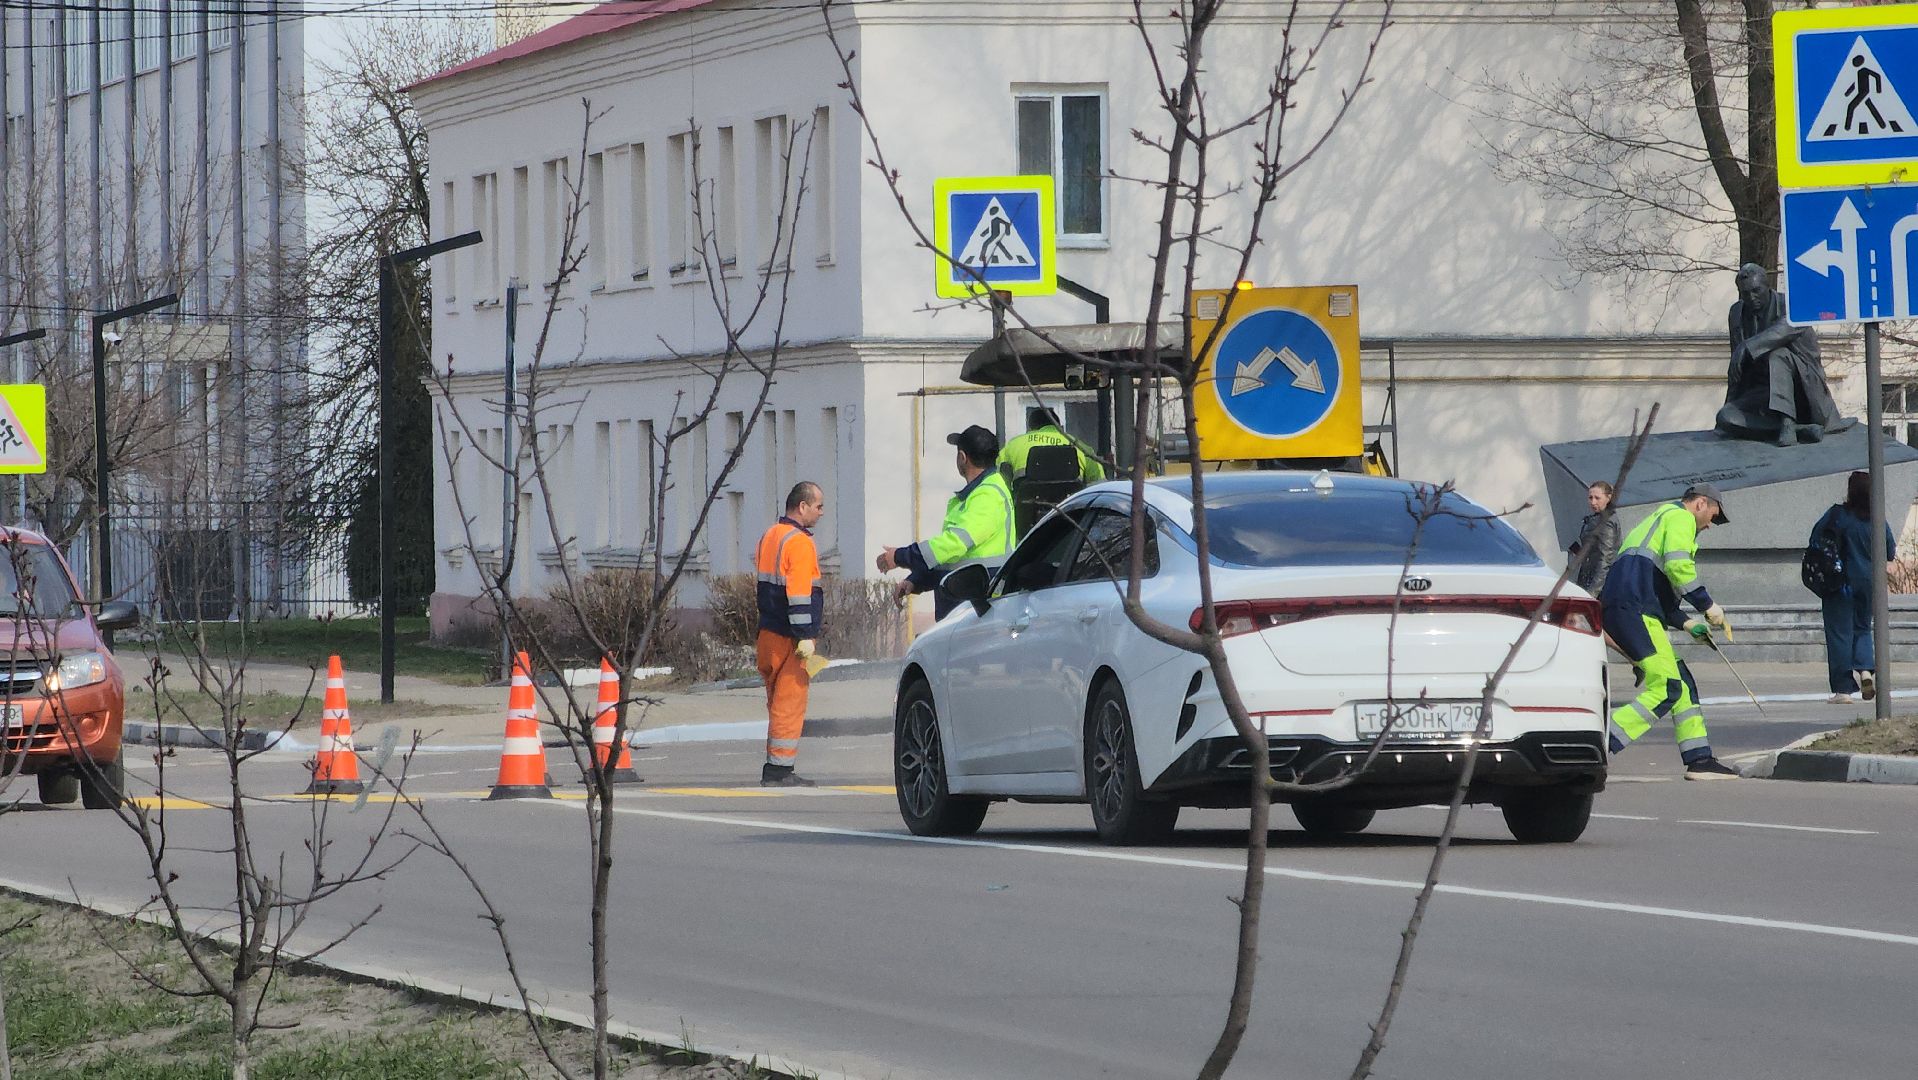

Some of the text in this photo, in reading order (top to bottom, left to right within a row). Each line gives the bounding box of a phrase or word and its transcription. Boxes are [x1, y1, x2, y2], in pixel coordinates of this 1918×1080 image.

[1028, 434, 1062, 446] ВЕКТОР
[1407, 580, 1428, 590] KIA
[1452, 706, 1484, 722] 790
